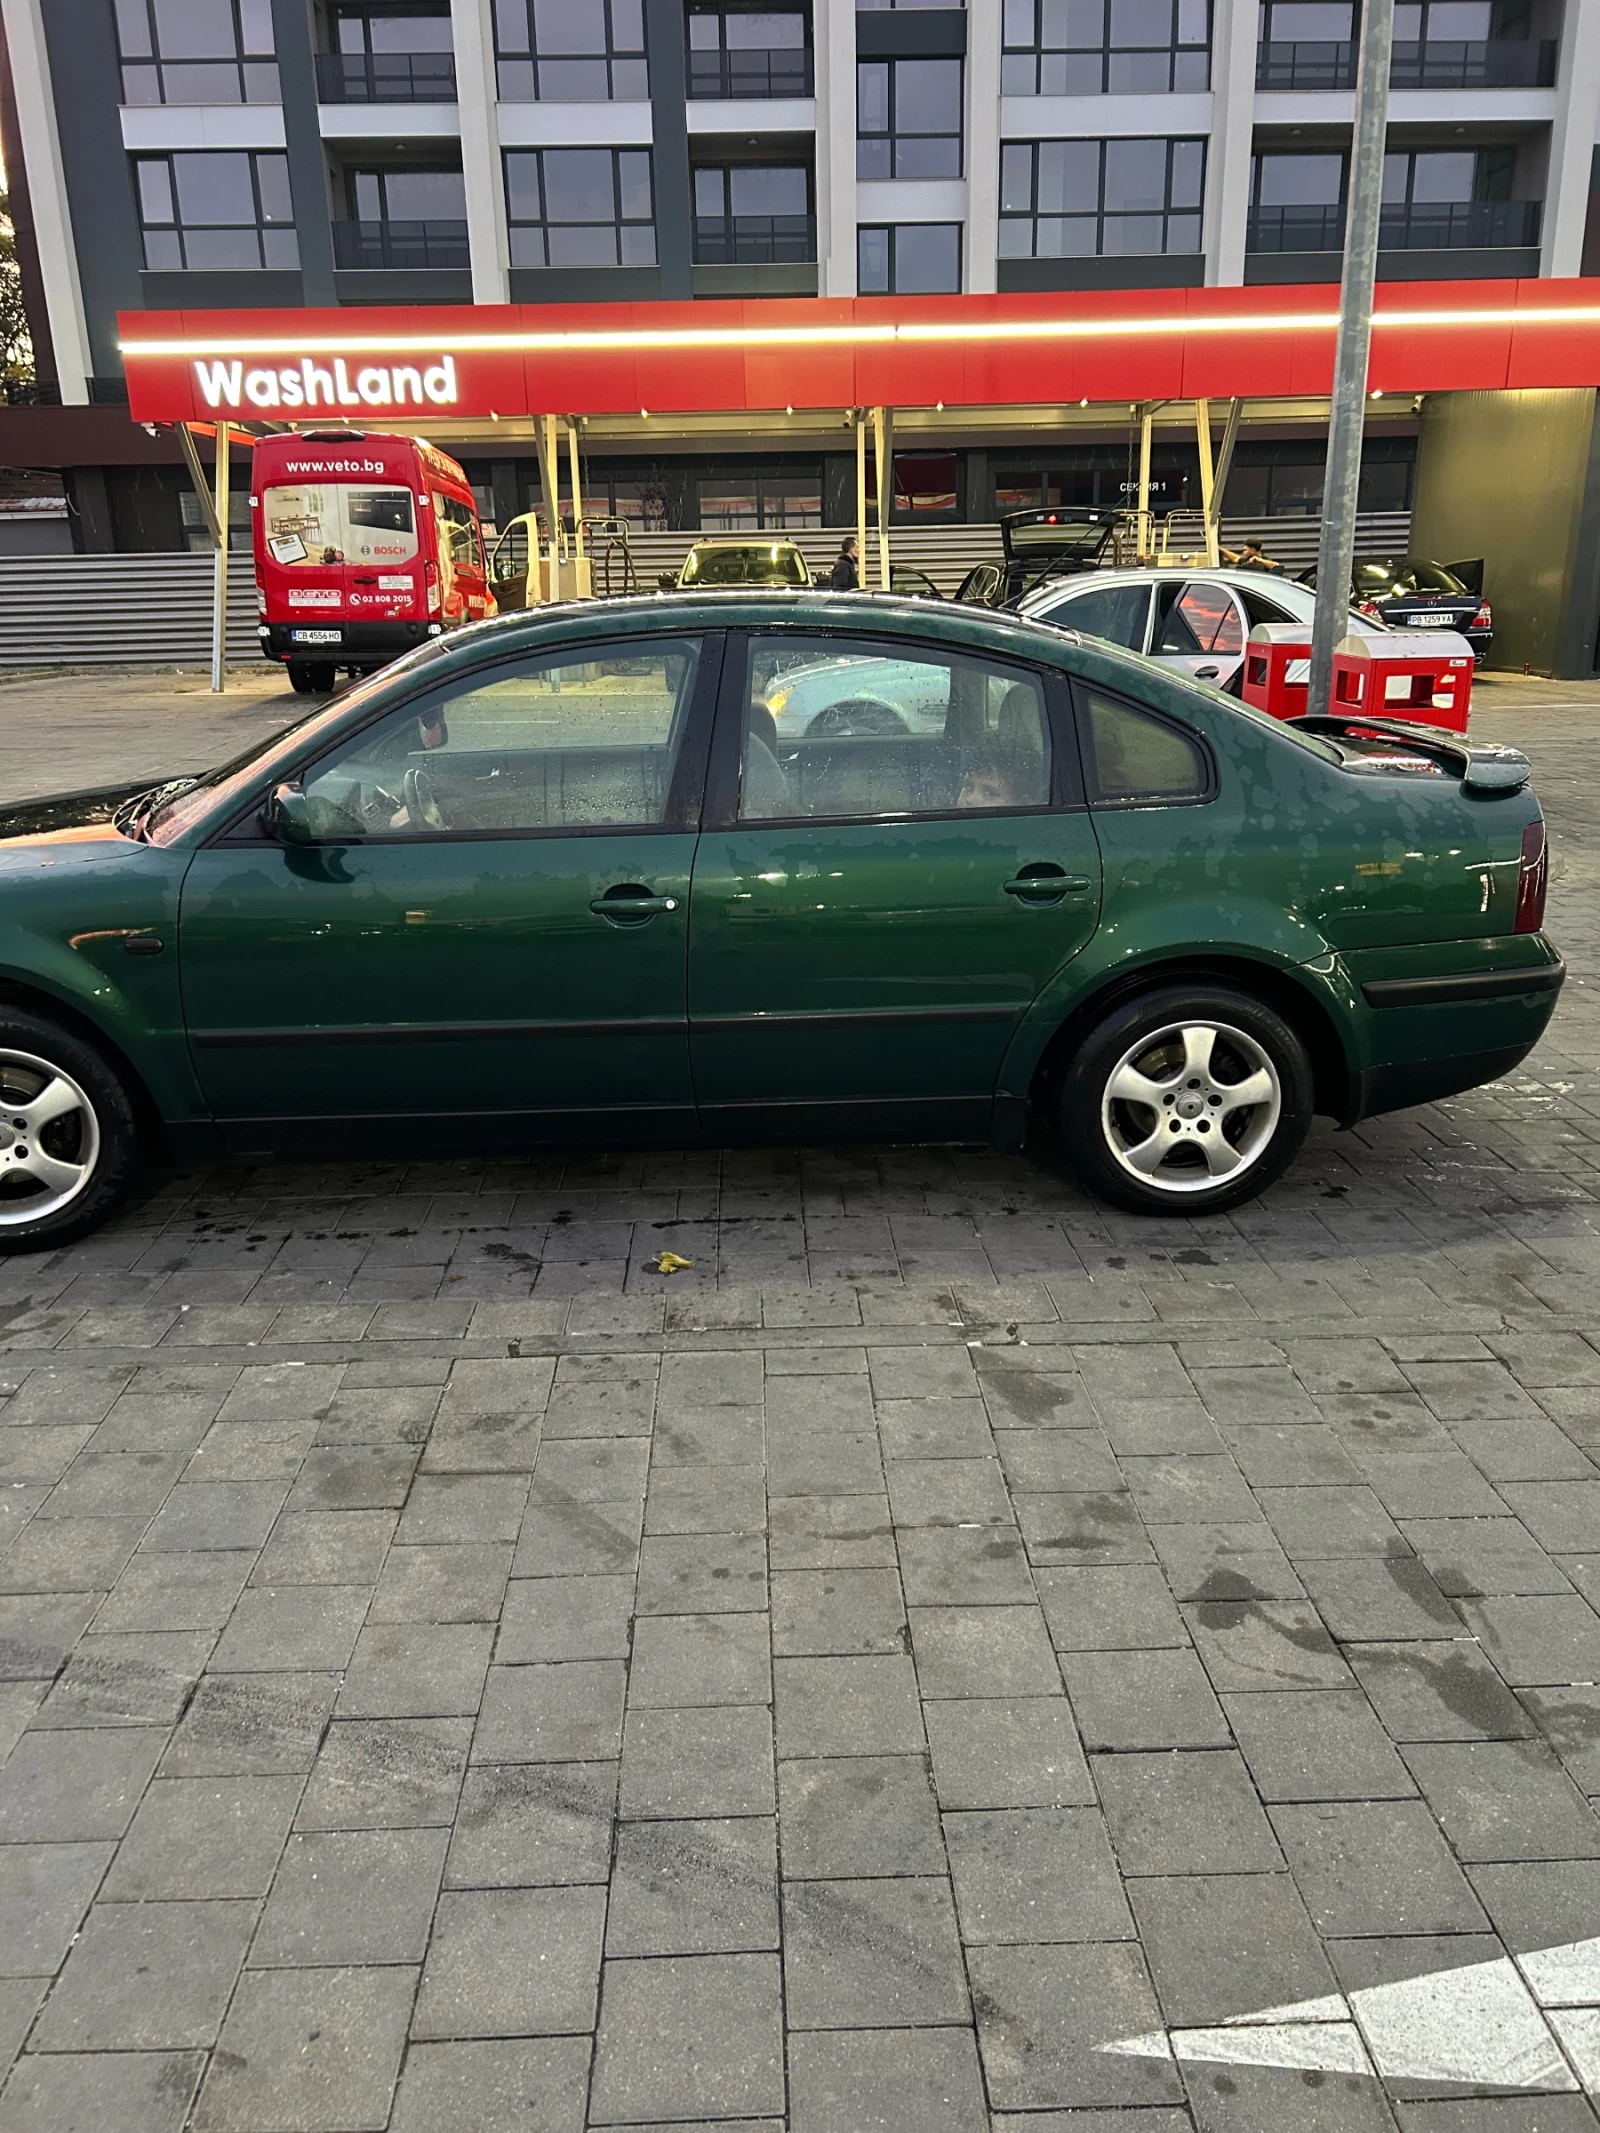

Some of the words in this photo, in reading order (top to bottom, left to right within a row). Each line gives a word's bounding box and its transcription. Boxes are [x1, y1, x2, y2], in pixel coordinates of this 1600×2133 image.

[194, 356, 457, 408] WashLand
[286, 459, 384, 474] www.veto.bg
[1161, 481, 1166, 491] 1
[374, 546, 406, 555] BOSCH
[362, 595, 373, 603] 02
[375, 595, 391, 603] 808
[392, 595, 412, 603] 2015
[1424, 615, 1441, 623] 1259
[298, 631, 308, 640] CB
[309, 631, 328, 640] 4556
[329, 632, 340, 640] HO
